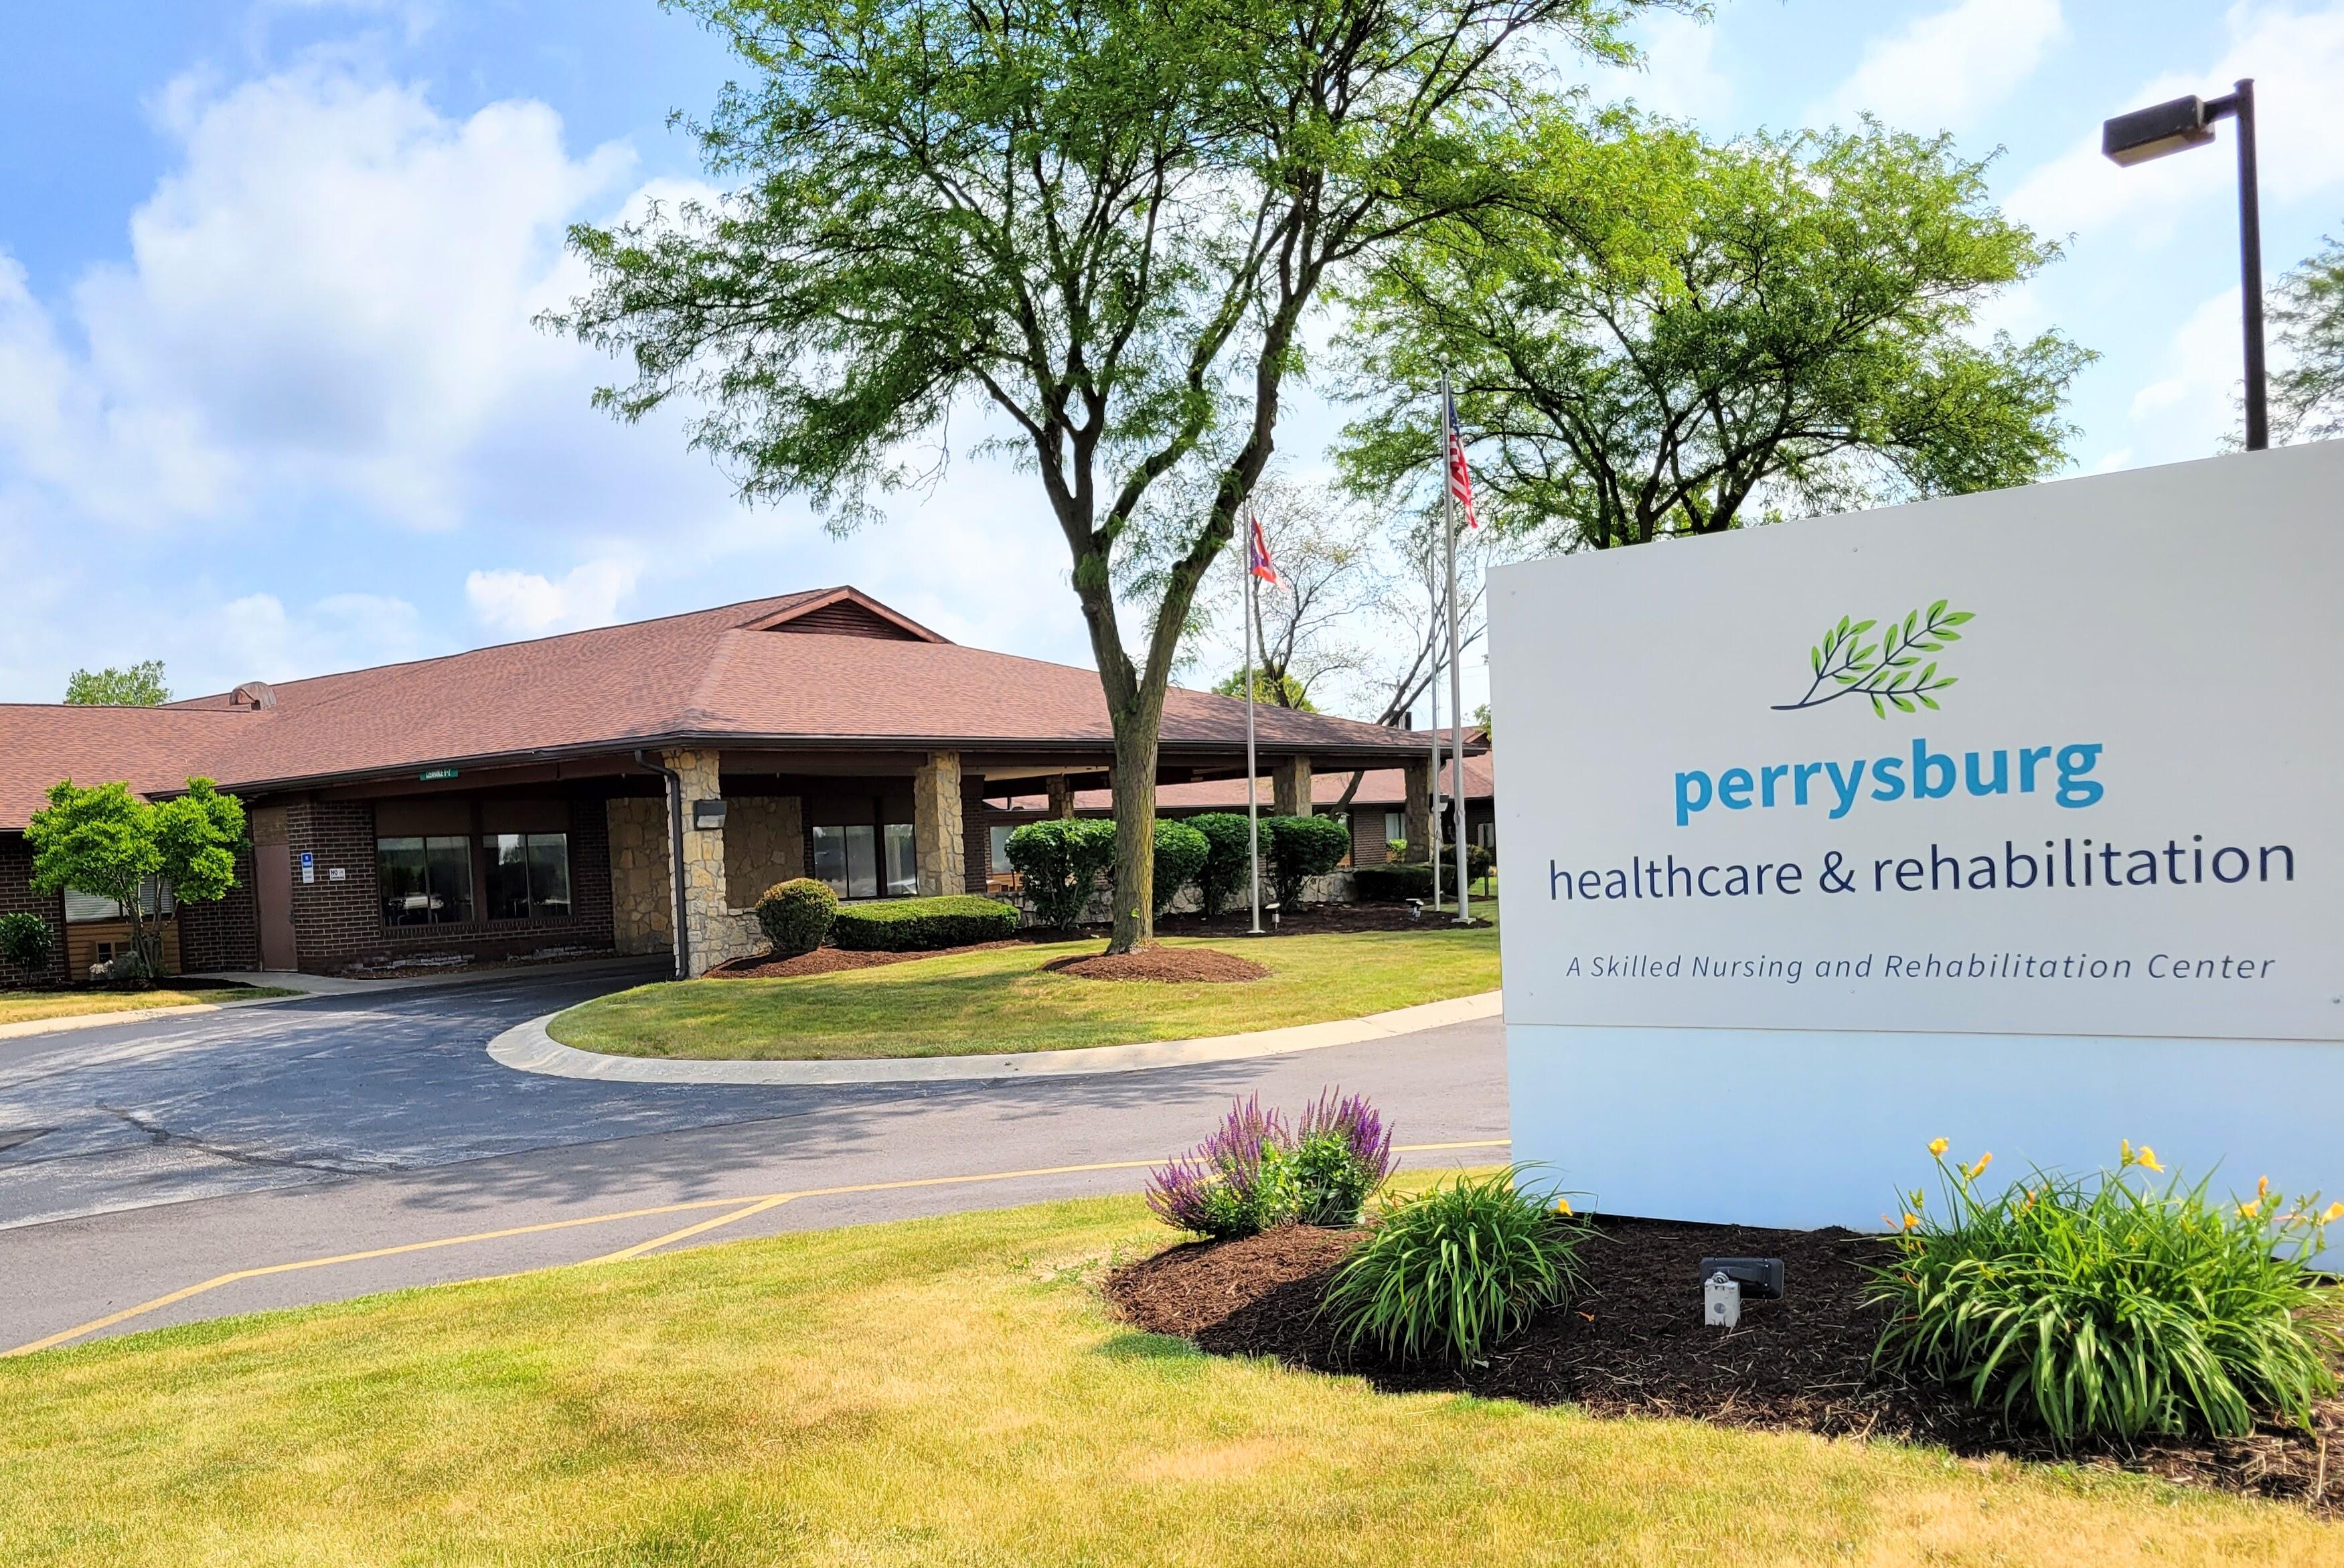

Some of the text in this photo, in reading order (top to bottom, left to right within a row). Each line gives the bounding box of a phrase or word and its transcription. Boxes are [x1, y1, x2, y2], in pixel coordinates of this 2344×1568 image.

[1674, 738, 2104, 827] perrysburg
[1550, 834, 2294, 900] healthcare & rehabilitation
[1565, 953, 2276, 984] A Skilled Nursing and Rehabilitation Center
